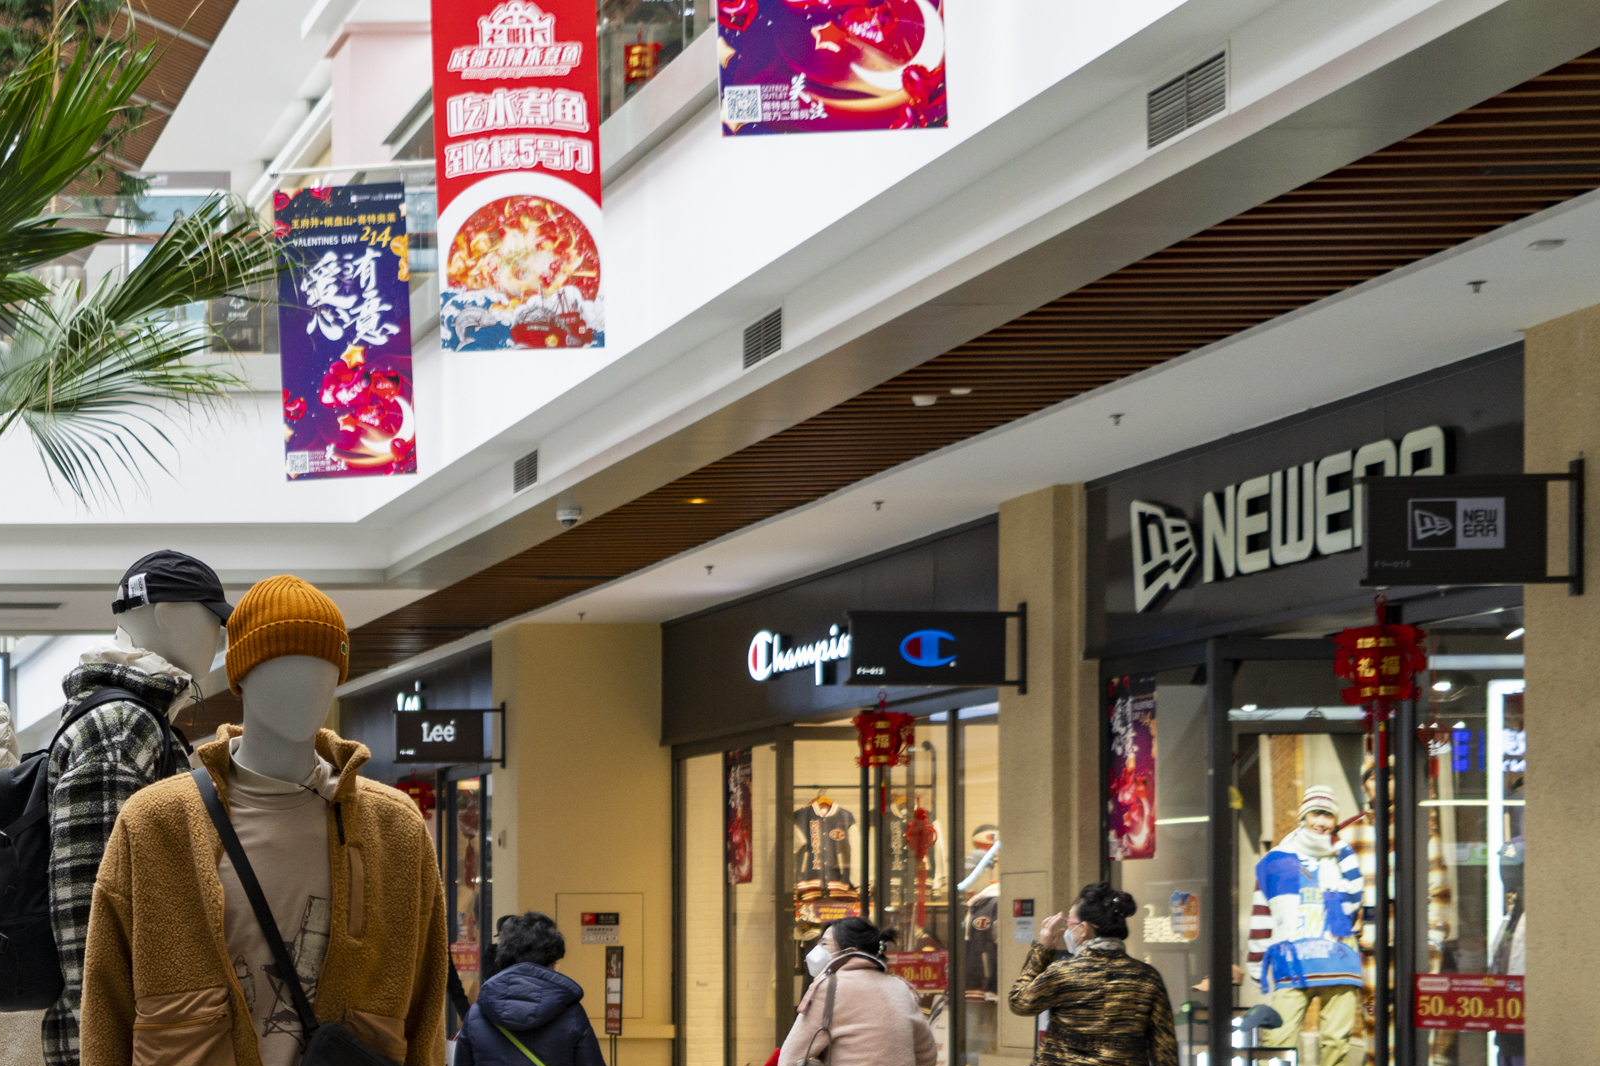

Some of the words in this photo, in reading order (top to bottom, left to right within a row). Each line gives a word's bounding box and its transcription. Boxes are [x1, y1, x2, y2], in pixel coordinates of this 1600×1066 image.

[448, 91, 587, 134] 吃水煮鱼
[446, 137, 592, 177] 到2楼5号门
[293, 237, 339, 247] VALENTINES
[341, 235, 358, 244] DAY
[359, 226, 392, 248] 214
[1463, 509, 1498, 523] NEW
[1463, 524, 1498, 538] ERA
[421, 721, 455, 742] Lee
[1418, 995, 1445, 1017] 50
[1457, 996, 1484, 1018] 30
[1495, 997, 1522, 1019] 10
